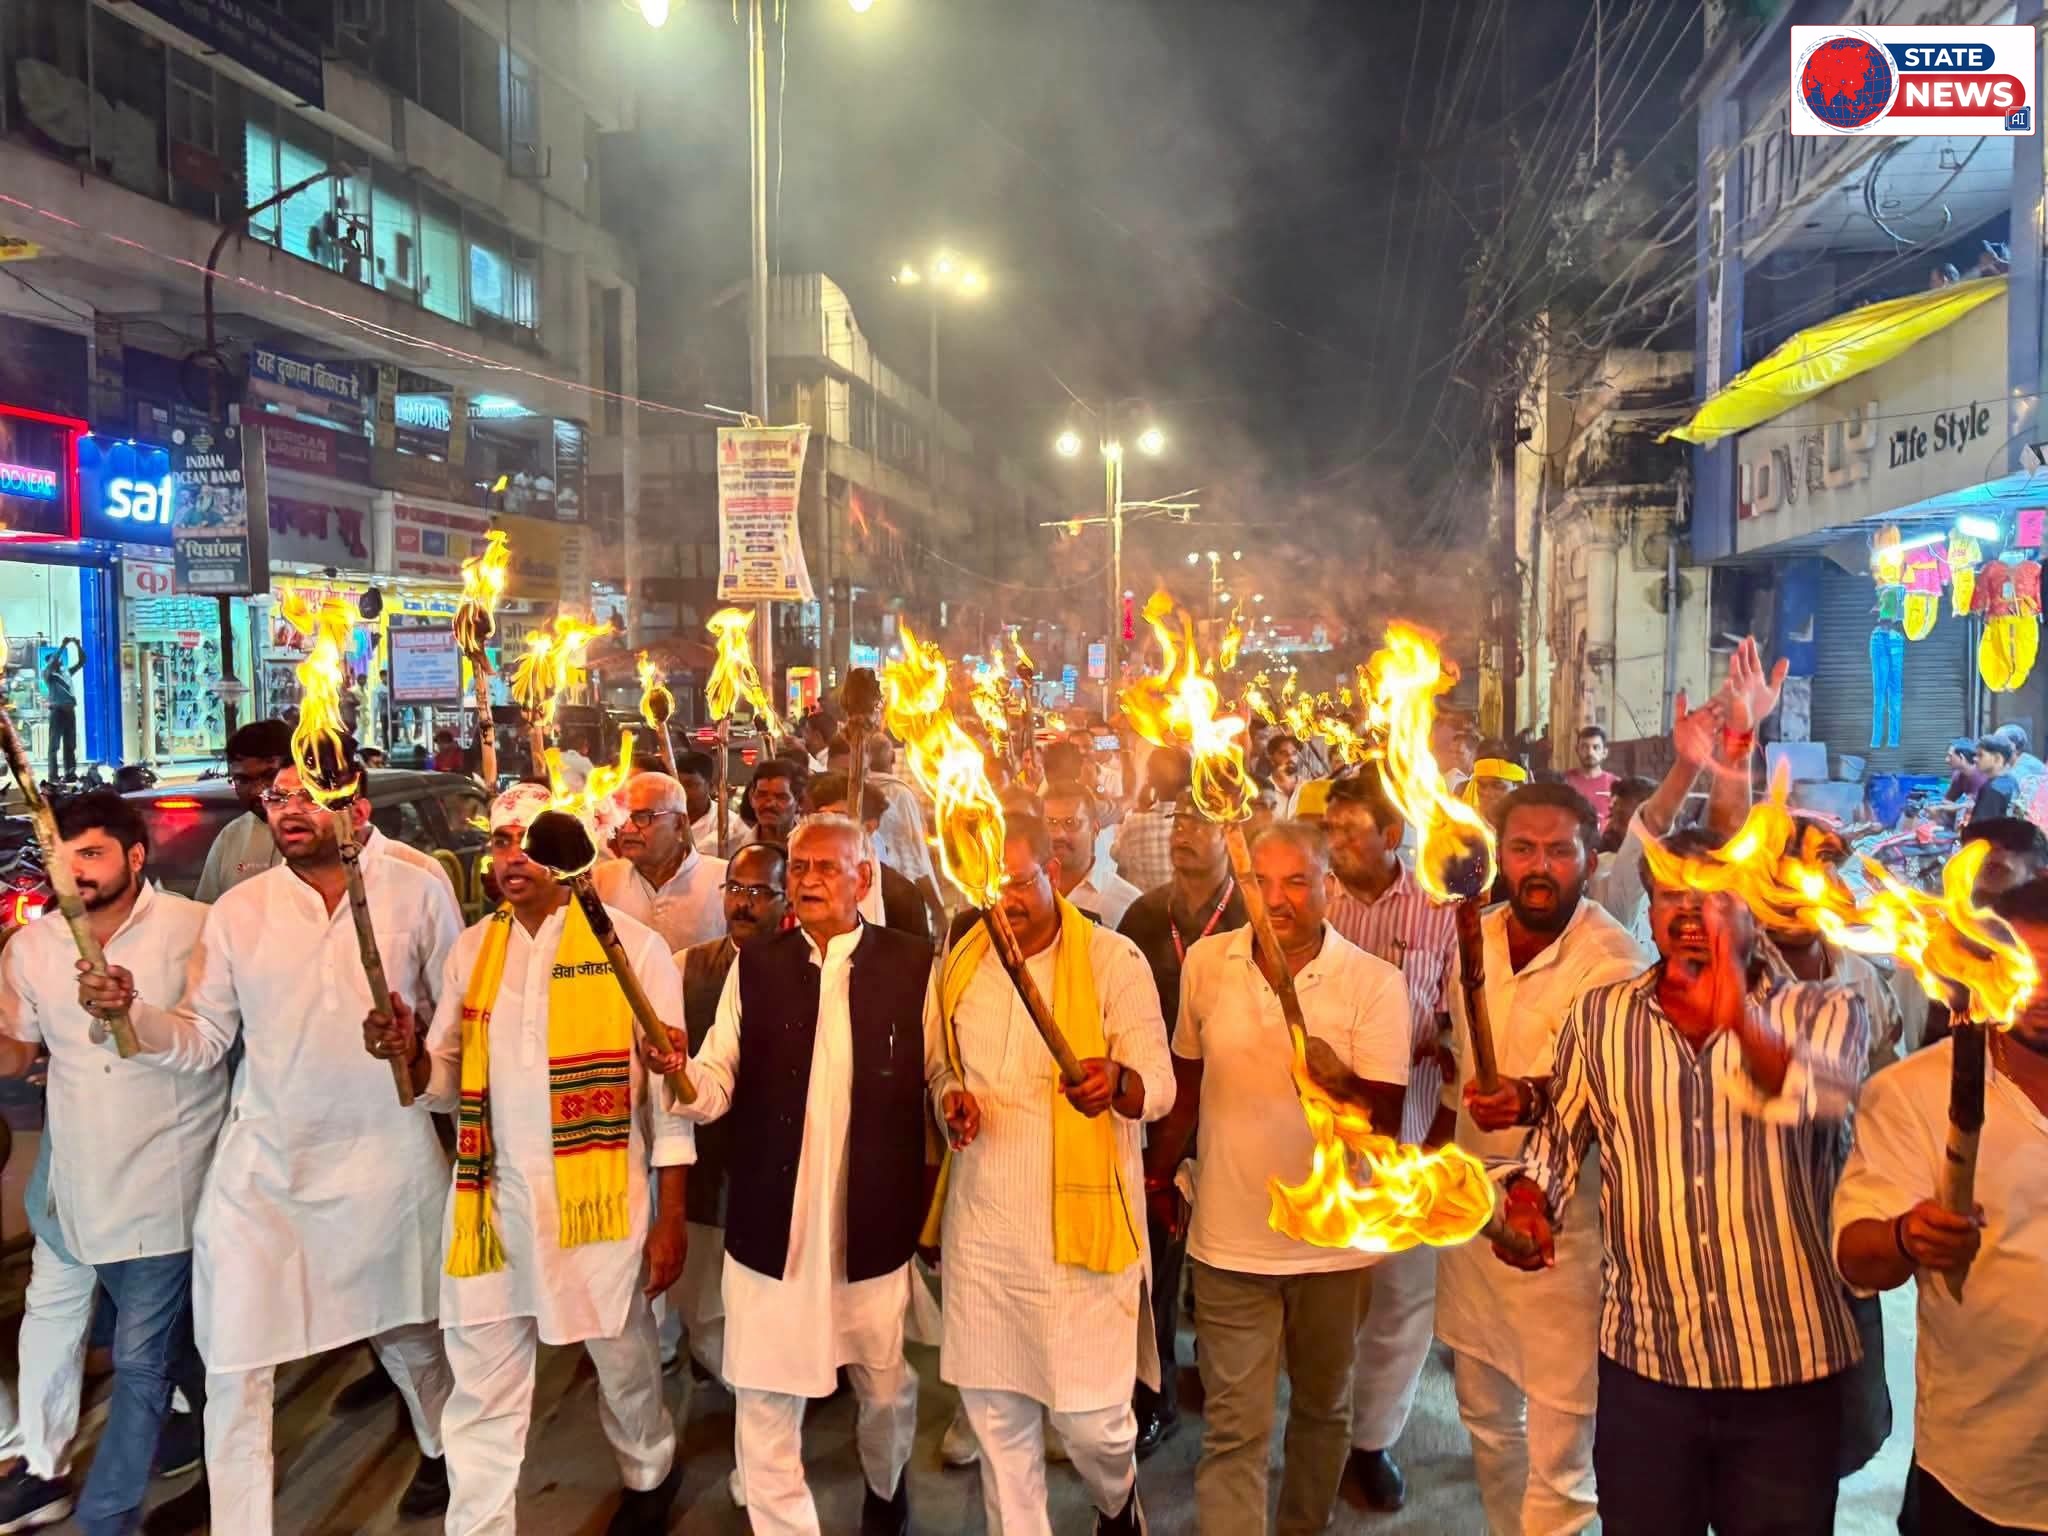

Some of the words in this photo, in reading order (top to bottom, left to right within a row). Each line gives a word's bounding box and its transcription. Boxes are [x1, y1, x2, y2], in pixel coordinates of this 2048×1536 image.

[256, 350, 276, 374] यह
[277, 356, 311, 385] दुकान
[1933, 400, 1990, 454] Style
[186, 454, 225, 469] INDIAN
[173, 470, 208, 485] OCEAN
[211, 470, 241, 484] BAND
[551, 963, 575, 979] सेवा
